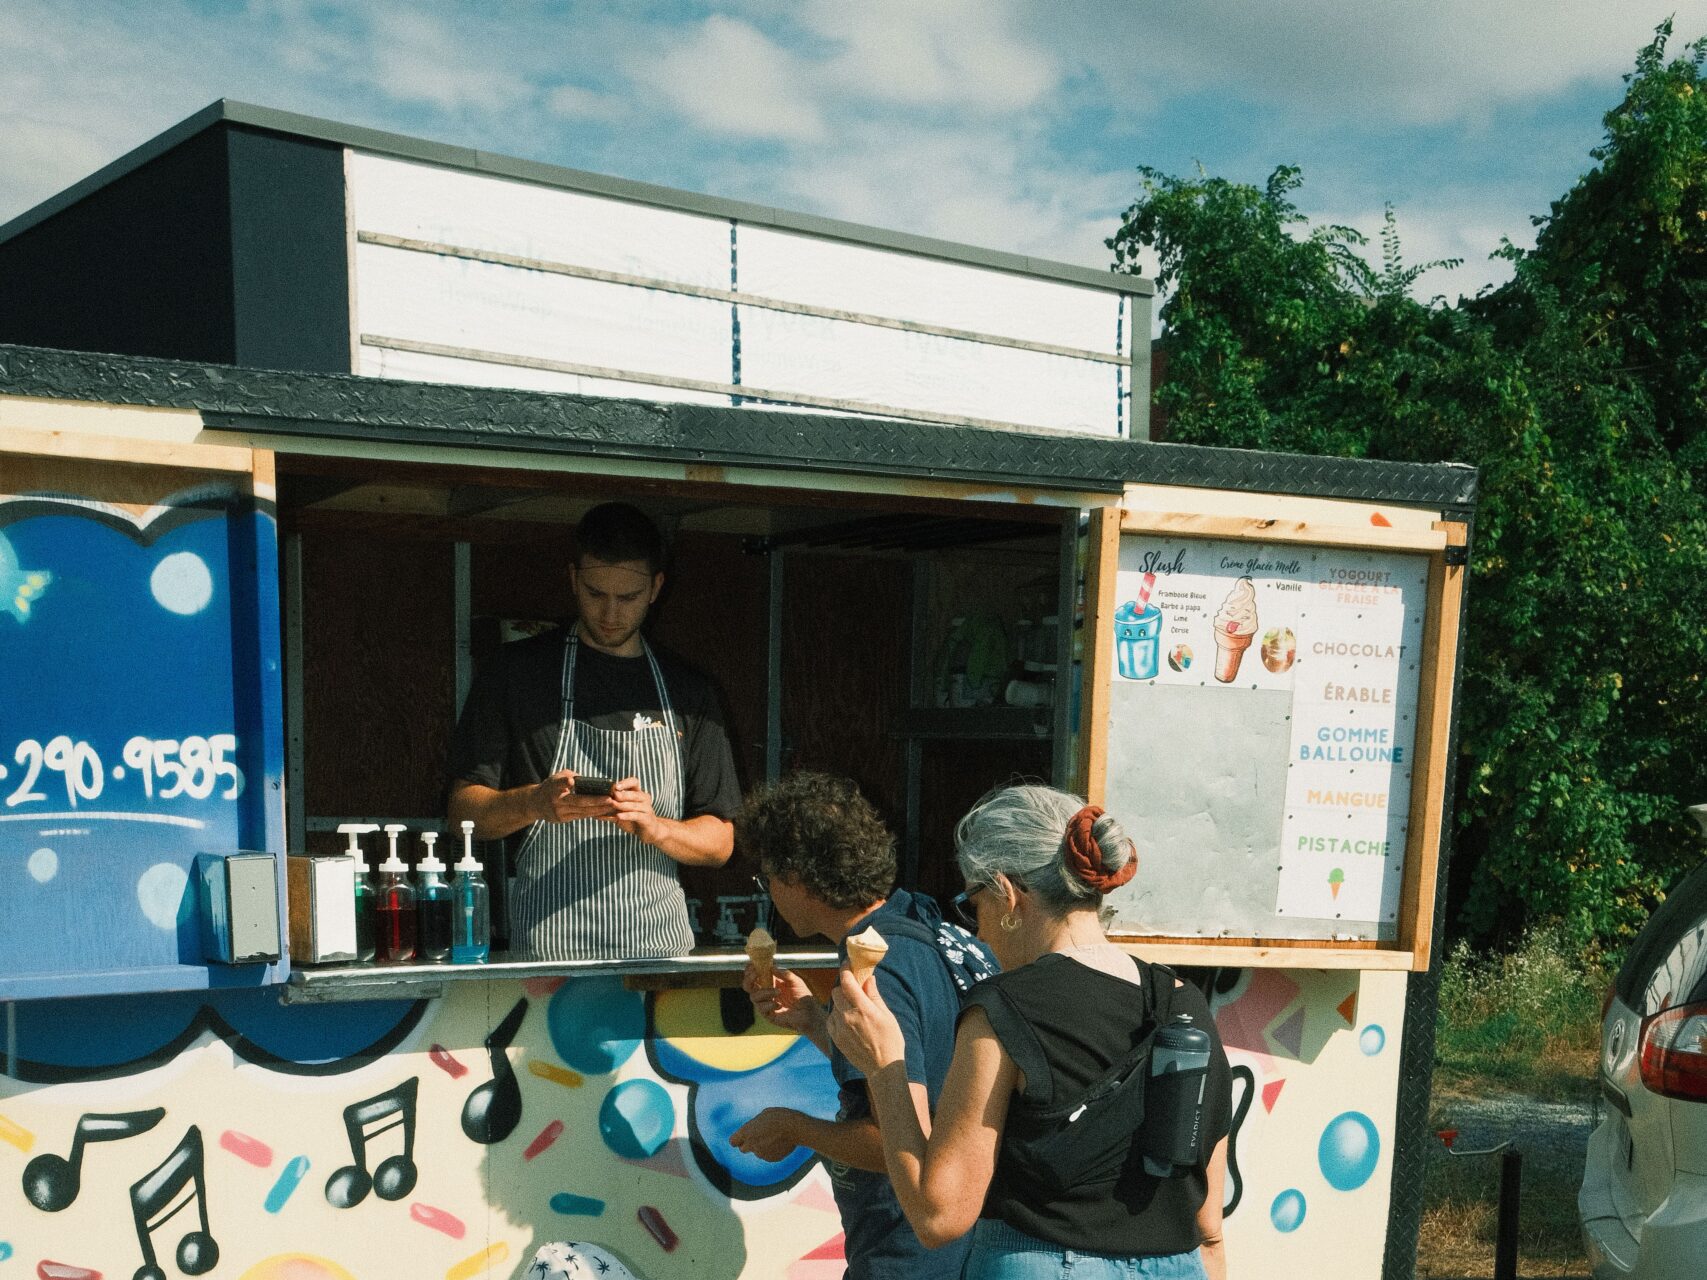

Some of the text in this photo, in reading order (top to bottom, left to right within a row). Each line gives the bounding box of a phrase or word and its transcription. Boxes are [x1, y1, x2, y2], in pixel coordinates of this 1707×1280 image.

[1139, 548, 1187, 576] Slush
[1275, 561, 1303, 574] Molle
[1329, 567, 1392, 582] YOGOURT
[1276, 581, 1303, 592] Vanille
[1161, 602, 1178, 610] Barbe
[1186, 604, 1201, 612] papa
[1337, 592, 1380, 606] FRAISE
[1313, 641, 1407, 659] CHOCOLAT
[1323, 682, 1392, 704] ÉRABLE
[1317, 727, 1389, 743] GOMME
[1300, 744, 1404, 763] BALLOUNE
[1306, 789, 1387, 808] MANGUE
[1297, 836, 1391, 857] PISTACHE
[1190, 1110, 1201, 1147] EVADICT
